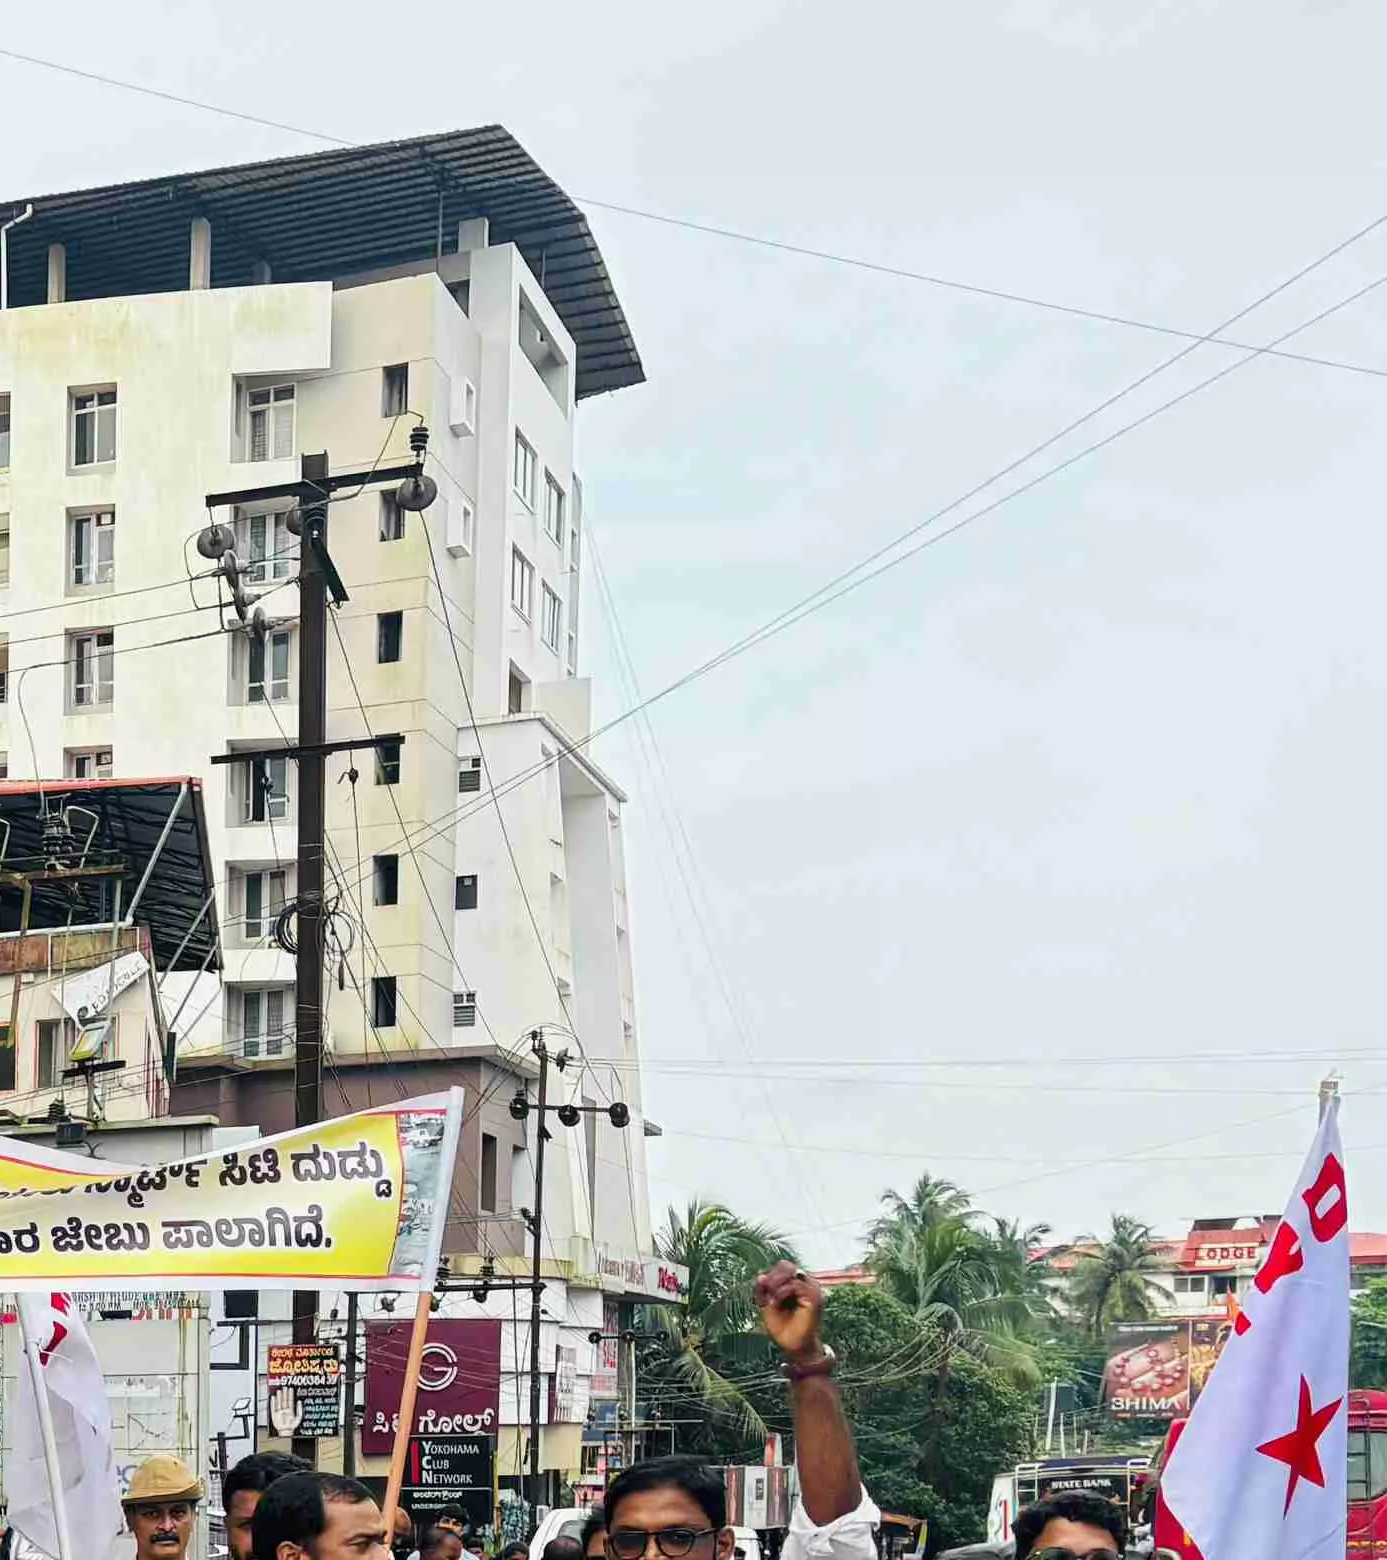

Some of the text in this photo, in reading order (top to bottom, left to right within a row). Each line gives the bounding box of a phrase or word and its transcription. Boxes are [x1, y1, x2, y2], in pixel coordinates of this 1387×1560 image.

[218, 1141, 394, 1199] ಸಿಟಿ ದುಡ್ಡು
[50, 1216, 151, 1252] ಜೇಬು
[161, 1206, 333, 1250] ಪಾಲಾಗಿದೆ.
[421, 1456, 450, 1470] CLUB
[421, 1472, 474, 1485] NETWORK
